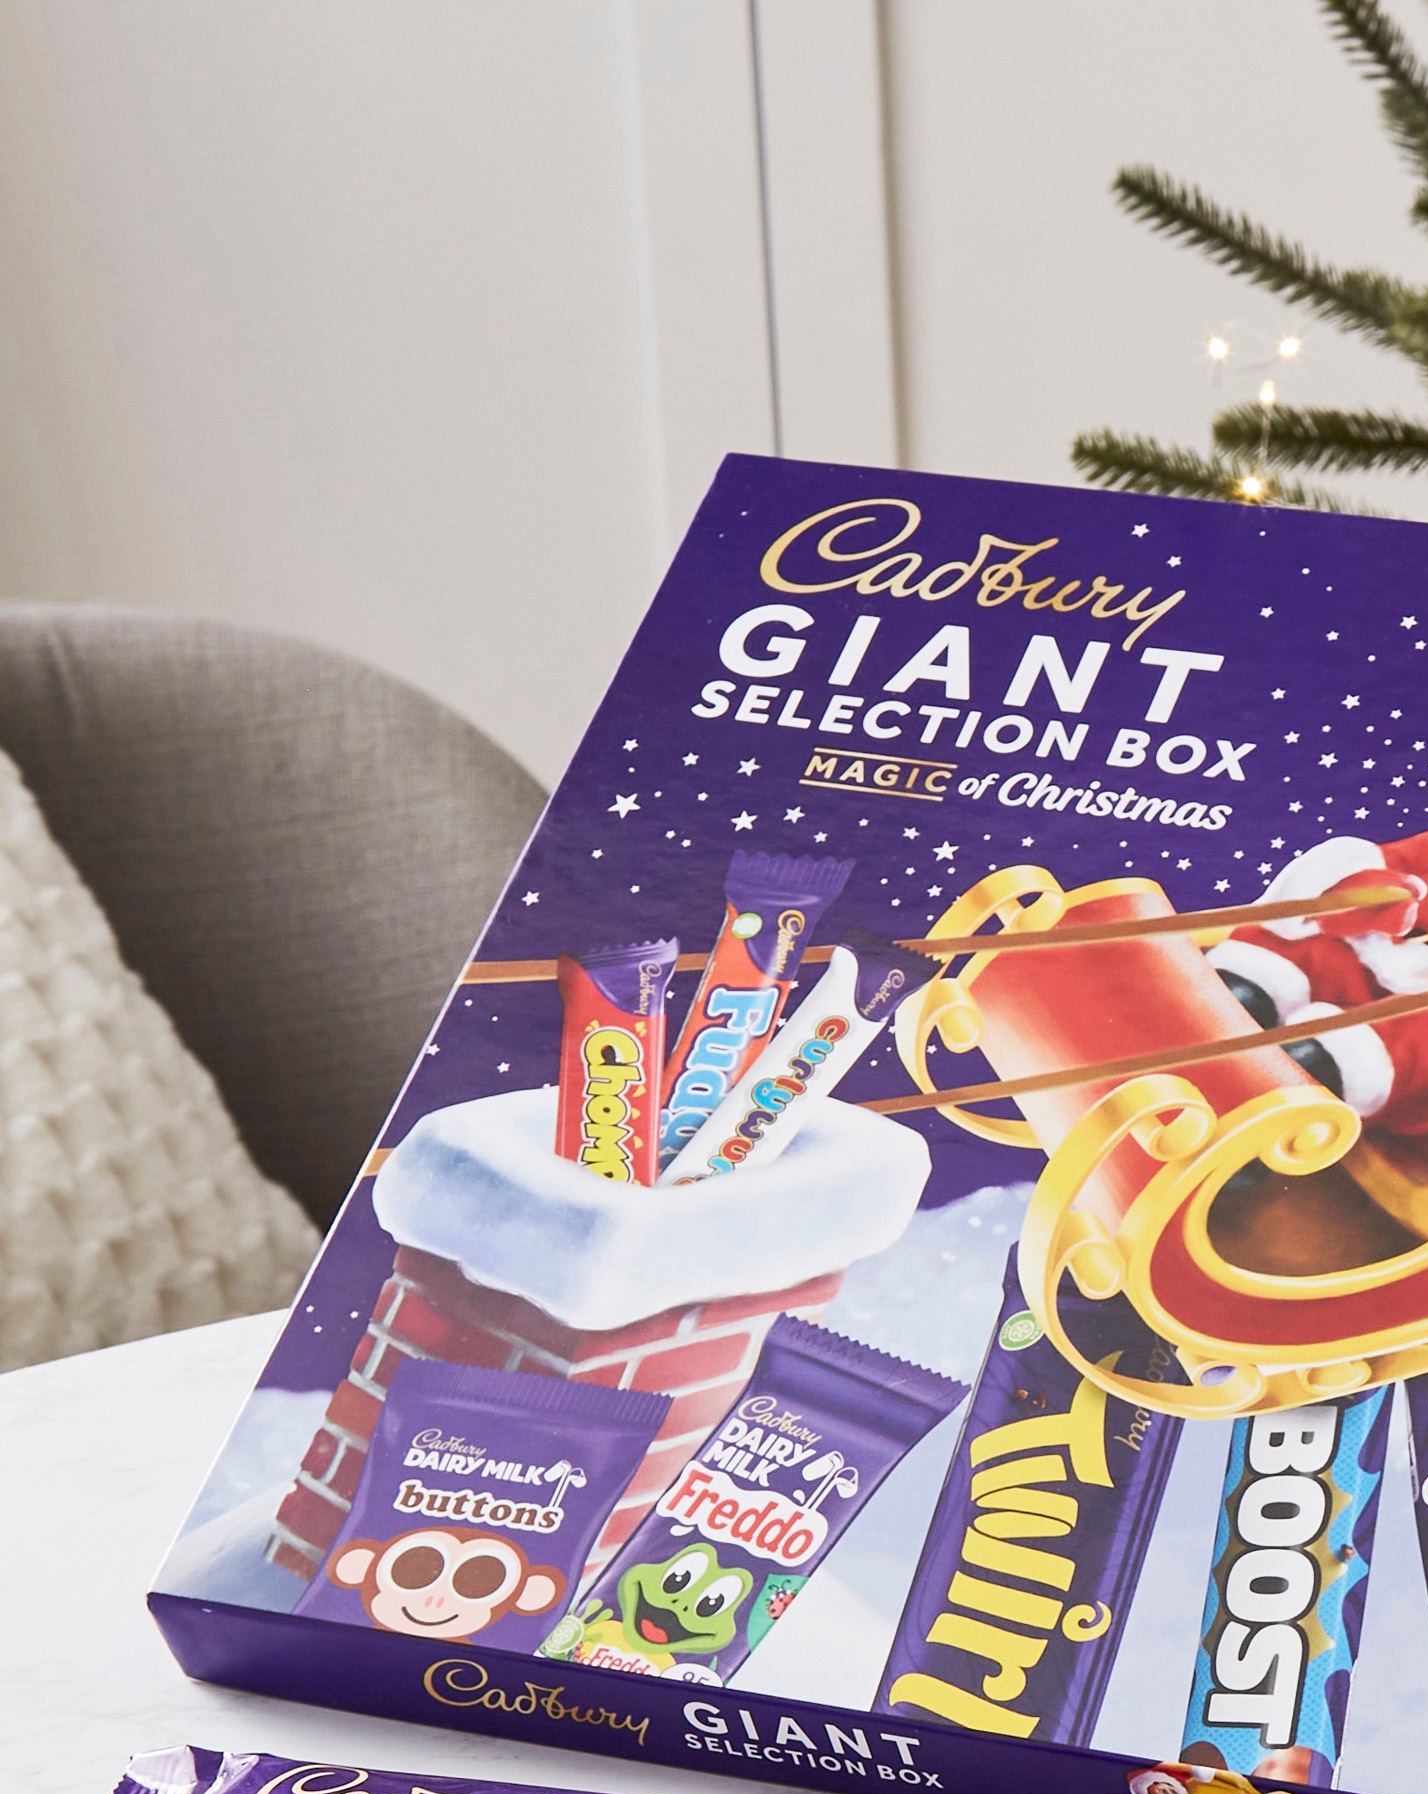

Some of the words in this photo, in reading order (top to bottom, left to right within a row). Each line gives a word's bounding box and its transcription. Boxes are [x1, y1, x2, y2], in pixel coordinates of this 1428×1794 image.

[759, 498, 1187, 652] Cadbury
[717, 603, 1225, 725] GIANT
[690, 679, 1090, 761] SELECTION
[1105, 728, 1259, 782] BOX
[804, 752, 954, 796] MAGIC
[957, 773, 992, 801] of
[996, 771, 1234, 831] Christmas
[411, 1429, 486, 1462] Cadbury
[717, 1419, 811, 1465] DAIRY
[736, 1397, 822, 1449] Cadbury
[402, 1447, 482, 1477] DAIRY
[483, 1456, 545, 1487] MILK
[704, 1445, 771, 1488] MILK
[399, 1485, 561, 1531] buttons
[665, 1470, 815, 1560] Freddo
[890, 1350, 1124, 1740] Twirl
[1207, 1404, 1339, 1751] BOOST
[423, 1657, 651, 1746] Cadbury
[682, 1701, 922, 1769] GIANT
[683, 1733, 872, 1777] SELECTION
[876, 1755, 944, 1789] BOX
